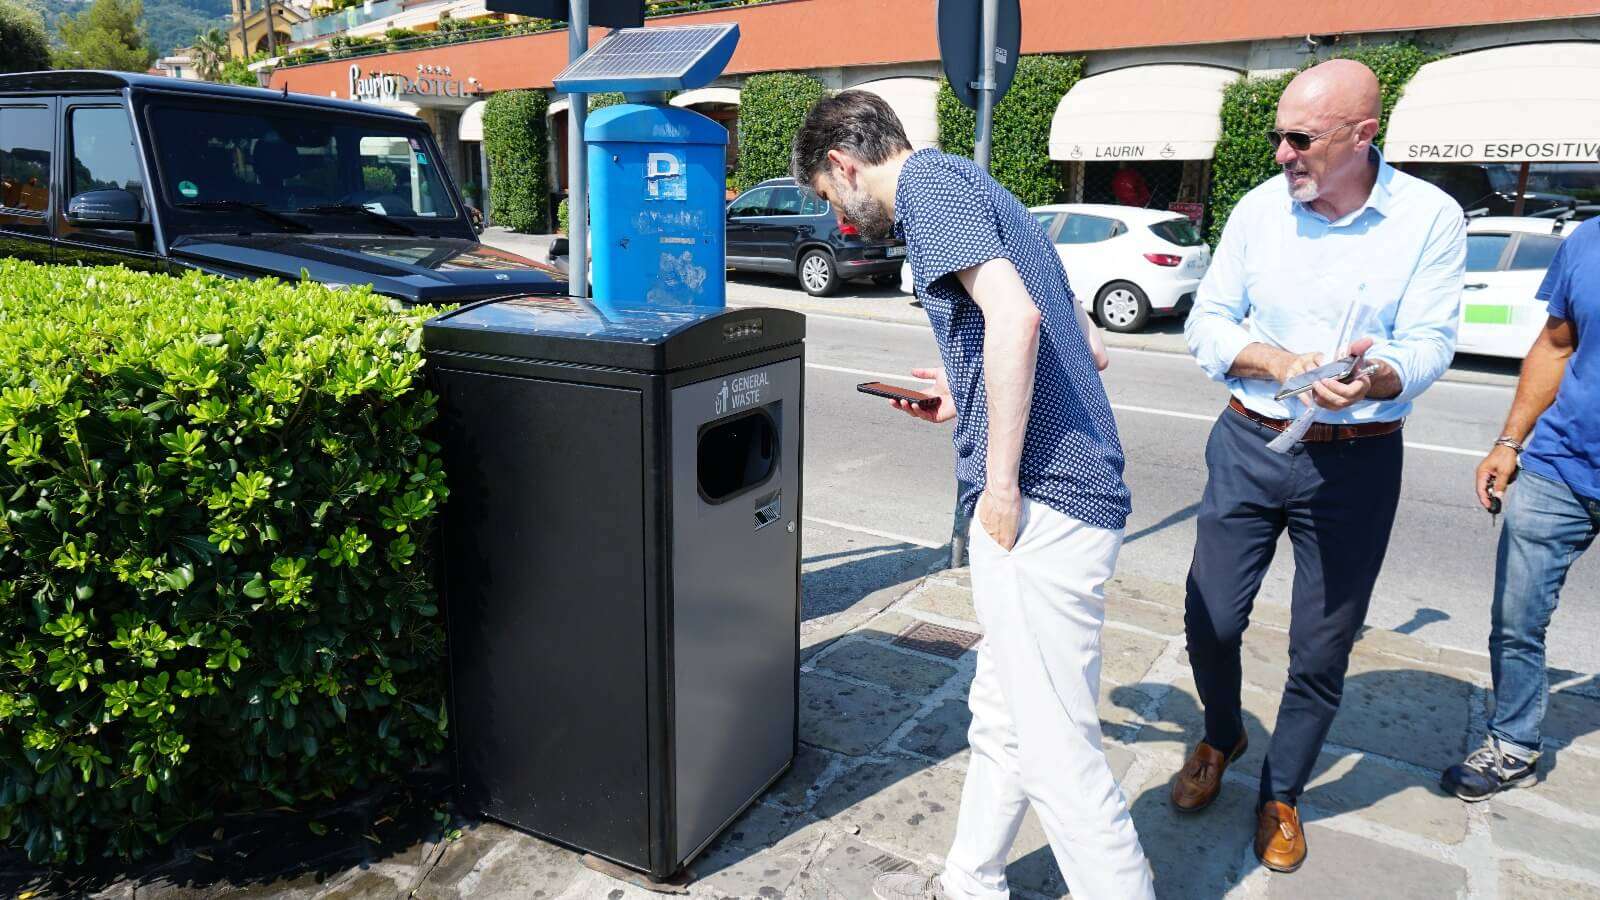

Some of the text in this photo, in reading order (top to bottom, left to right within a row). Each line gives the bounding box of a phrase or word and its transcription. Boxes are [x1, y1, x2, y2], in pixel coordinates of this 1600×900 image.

[1095, 145, 1145, 158] LAURIN
[1408, 144, 1474, 158] SPAZIO
[647, 152, 681, 197] P
[731, 371, 769, 393] GENERAL
[731, 389, 761, 409] WASTE
